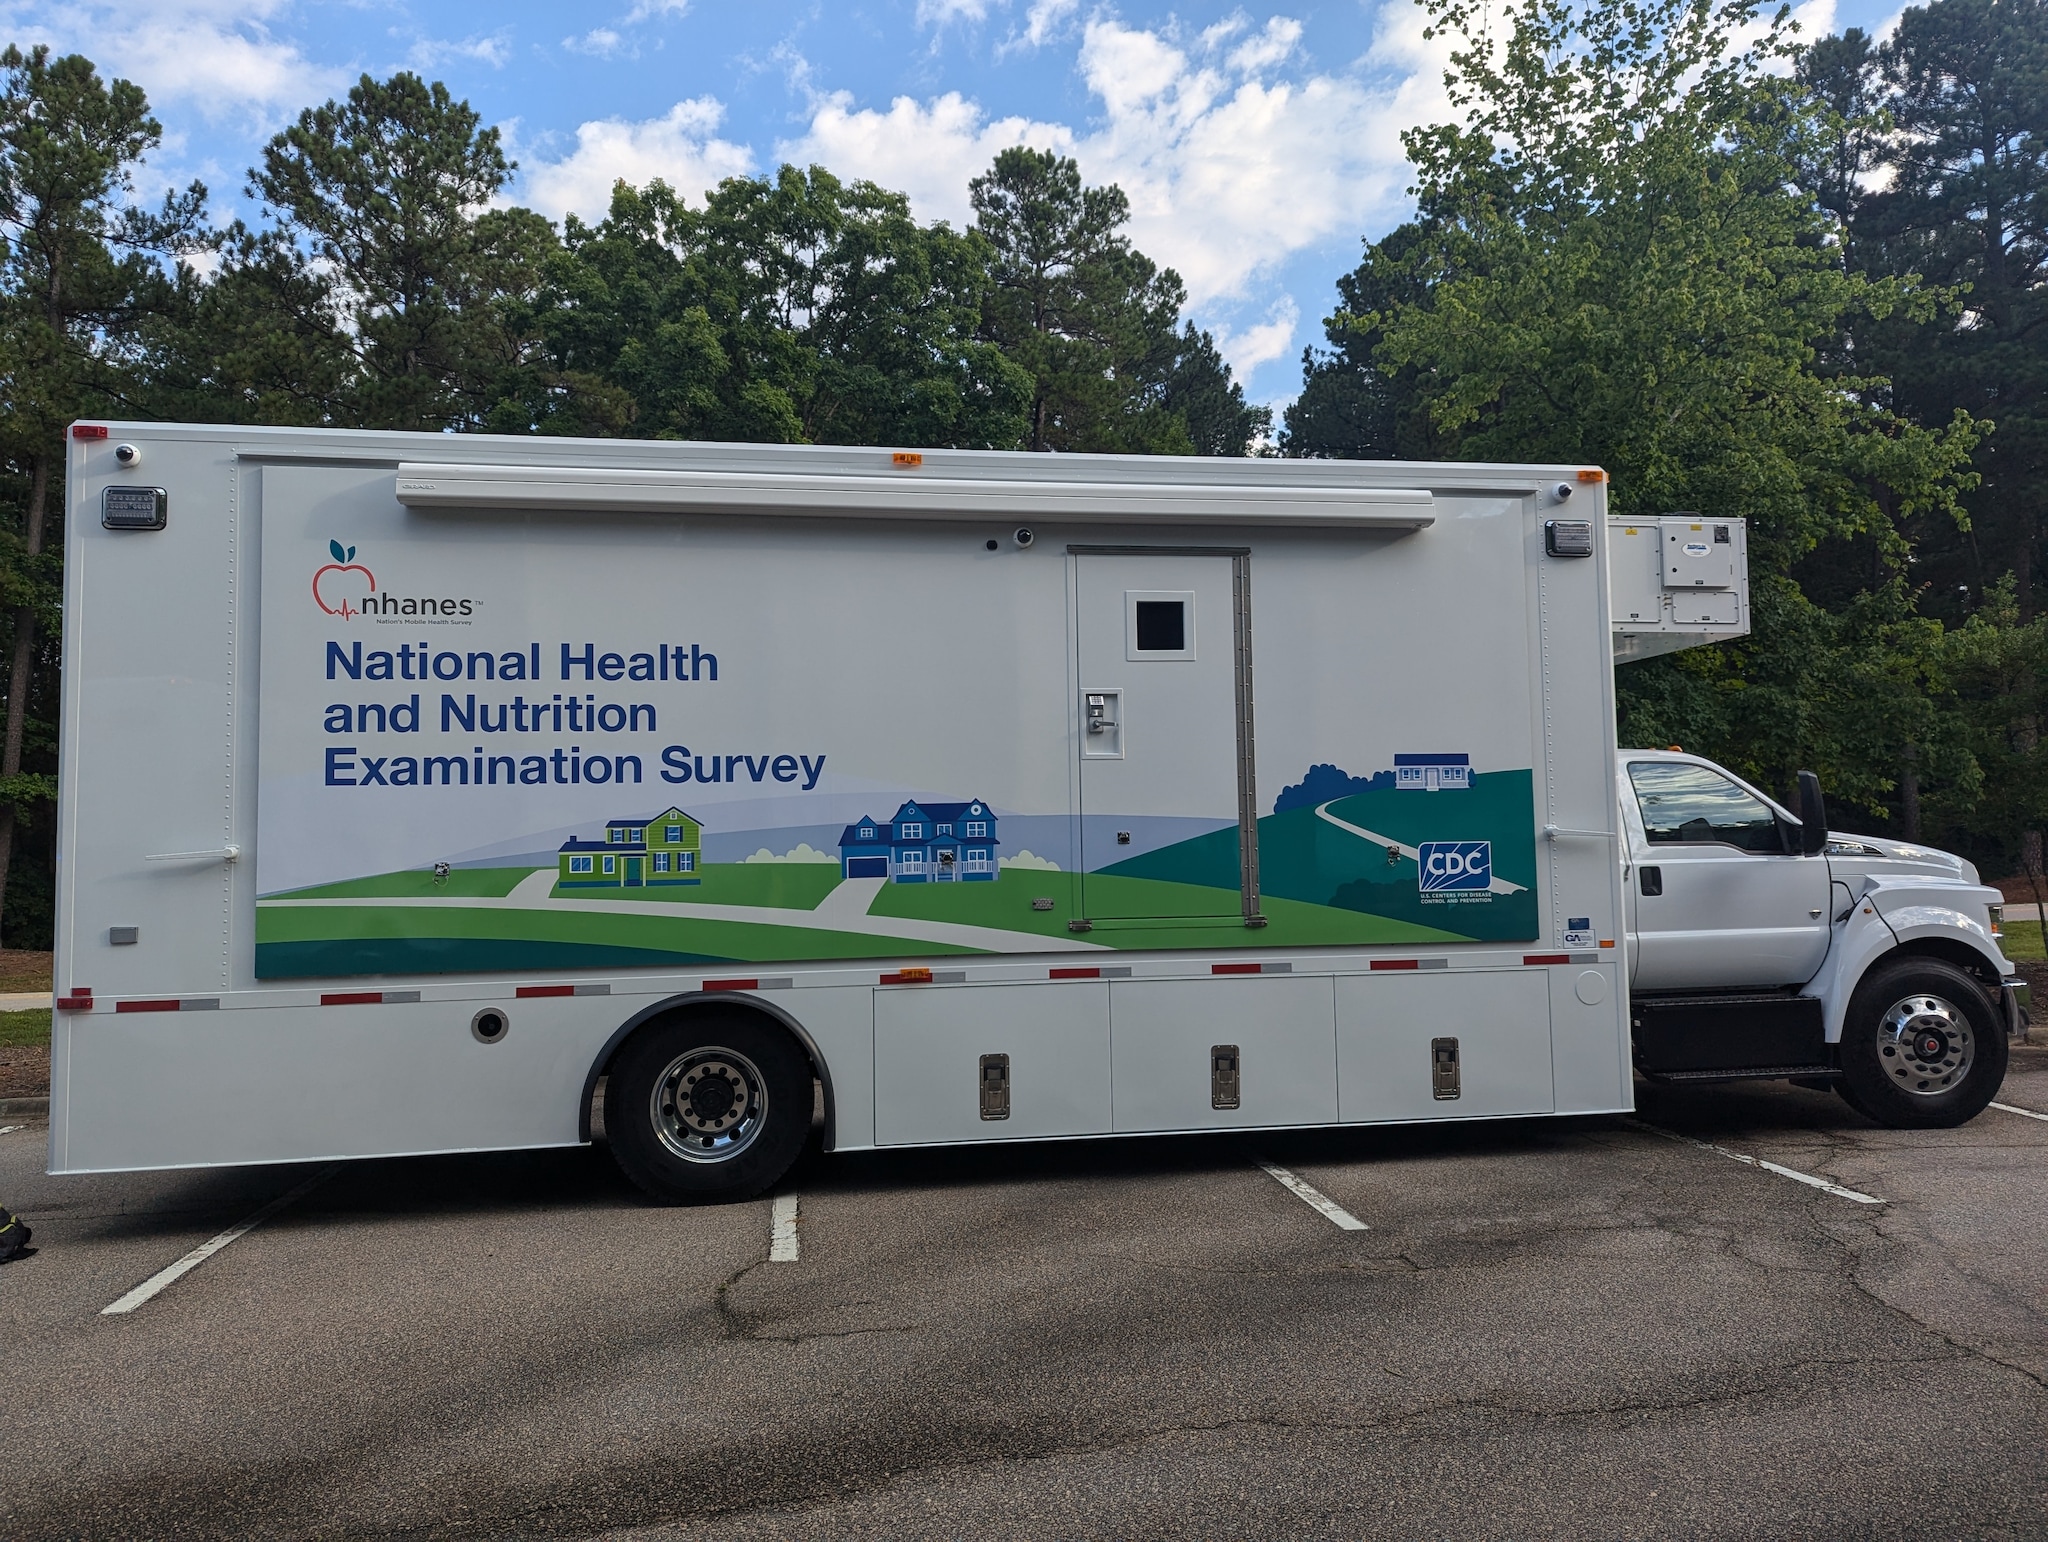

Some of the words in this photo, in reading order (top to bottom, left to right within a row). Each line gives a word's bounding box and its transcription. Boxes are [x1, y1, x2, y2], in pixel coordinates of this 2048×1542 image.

[362, 592, 473, 616] nhanes
[450, 619, 473, 627] Survey
[326, 641, 540, 681] National
[560, 642, 718, 681] Health
[323, 694, 420, 733] and
[440, 694, 657, 733] Nutrition
[324, 746, 642, 787] Examination
[659, 745, 827, 791] Survey
[1428, 852, 1483, 875] CDC
